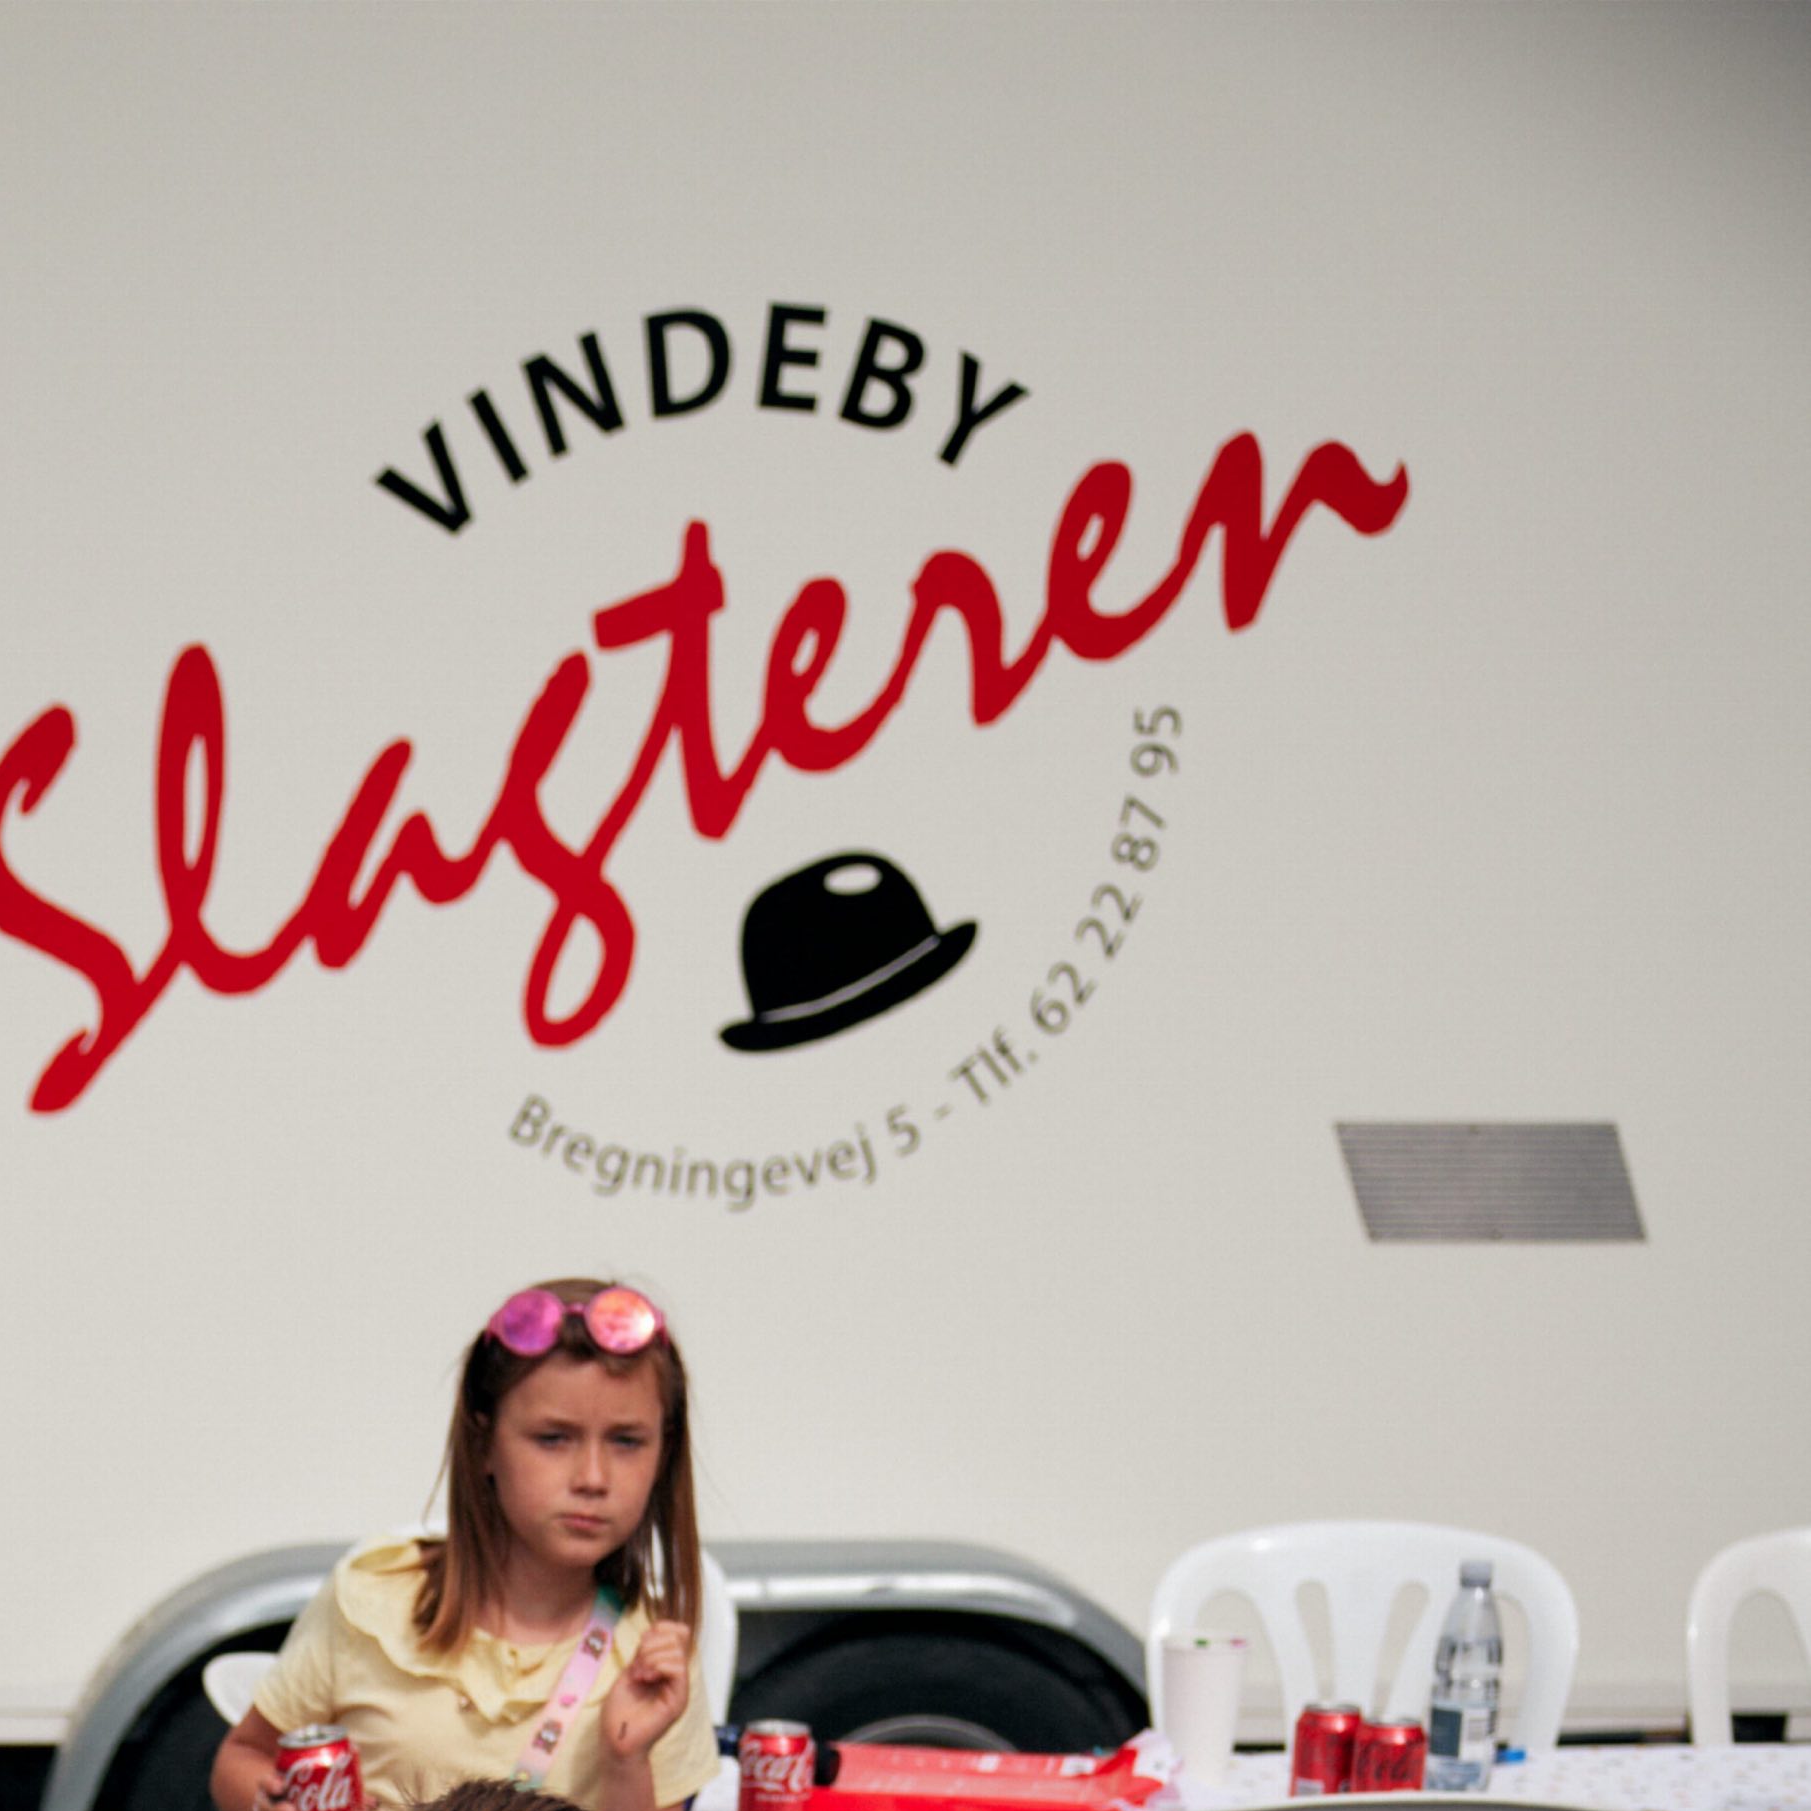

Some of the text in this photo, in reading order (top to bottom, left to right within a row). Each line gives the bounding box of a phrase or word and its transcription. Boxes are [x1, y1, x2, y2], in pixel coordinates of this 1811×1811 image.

[375, 301, 1029, 537] VINDEBY
[1128, 703, 1183, 778] 95
[1110, 792, 1167, 873] 87
[1075, 881, 1143, 960] 22
[1028, 960, 1098, 1037] 62
[947, 1026, 1038, 1106] Tlf.
[508, 1093, 879, 1212] Bregningevej
[887, 1103, 922, 1158] 5
